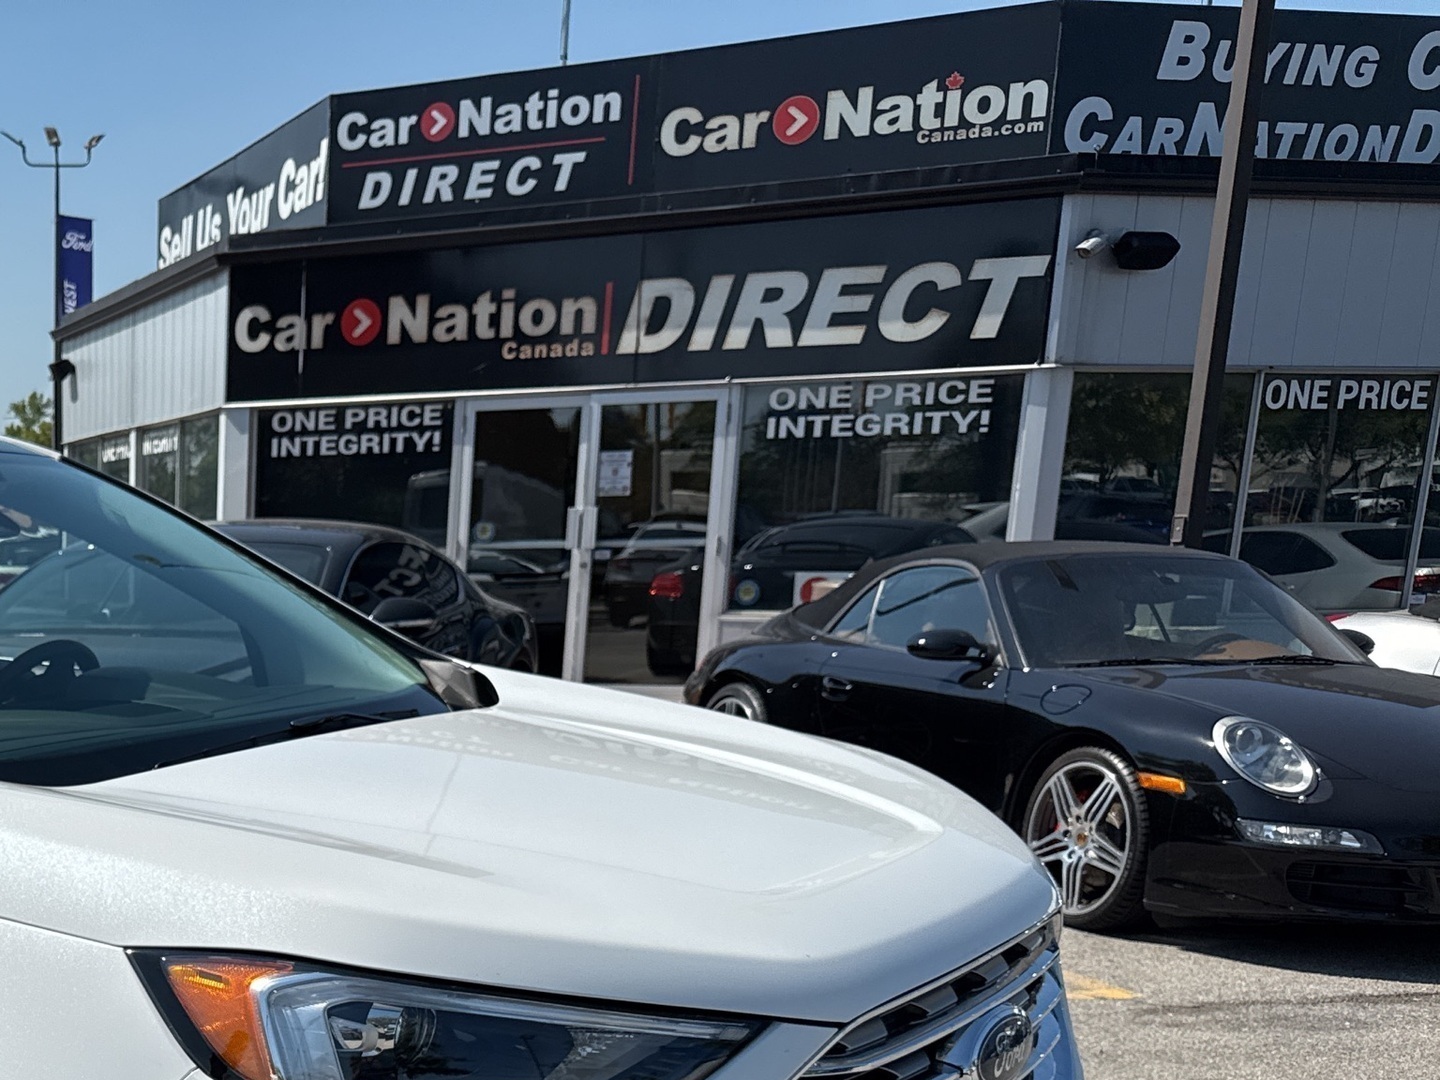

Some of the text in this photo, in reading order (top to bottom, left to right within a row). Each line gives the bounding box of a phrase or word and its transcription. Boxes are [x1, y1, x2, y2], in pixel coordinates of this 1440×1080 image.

[336, 88, 622, 152] Car Nation
[660, 74, 1050, 158] Car Nation
[916, 118, 1045, 145] Canada.com
[356, 150, 588, 211] DIRECT
[158, 137, 330, 270] Sell Us Your Car!
[234, 288, 599, 354] Car Nation
[615, 254, 1052, 355] DIRECT
[501, 338, 595, 361] Canada
[768, 378, 995, 411] ONE PRICE
[1265, 378, 1432, 411] ONE PRICE
[271, 404, 444, 433] ONE PRICE
[765, 409, 991, 440] INTEGRITY!
[270, 431, 442, 458] INTEGRITY!
